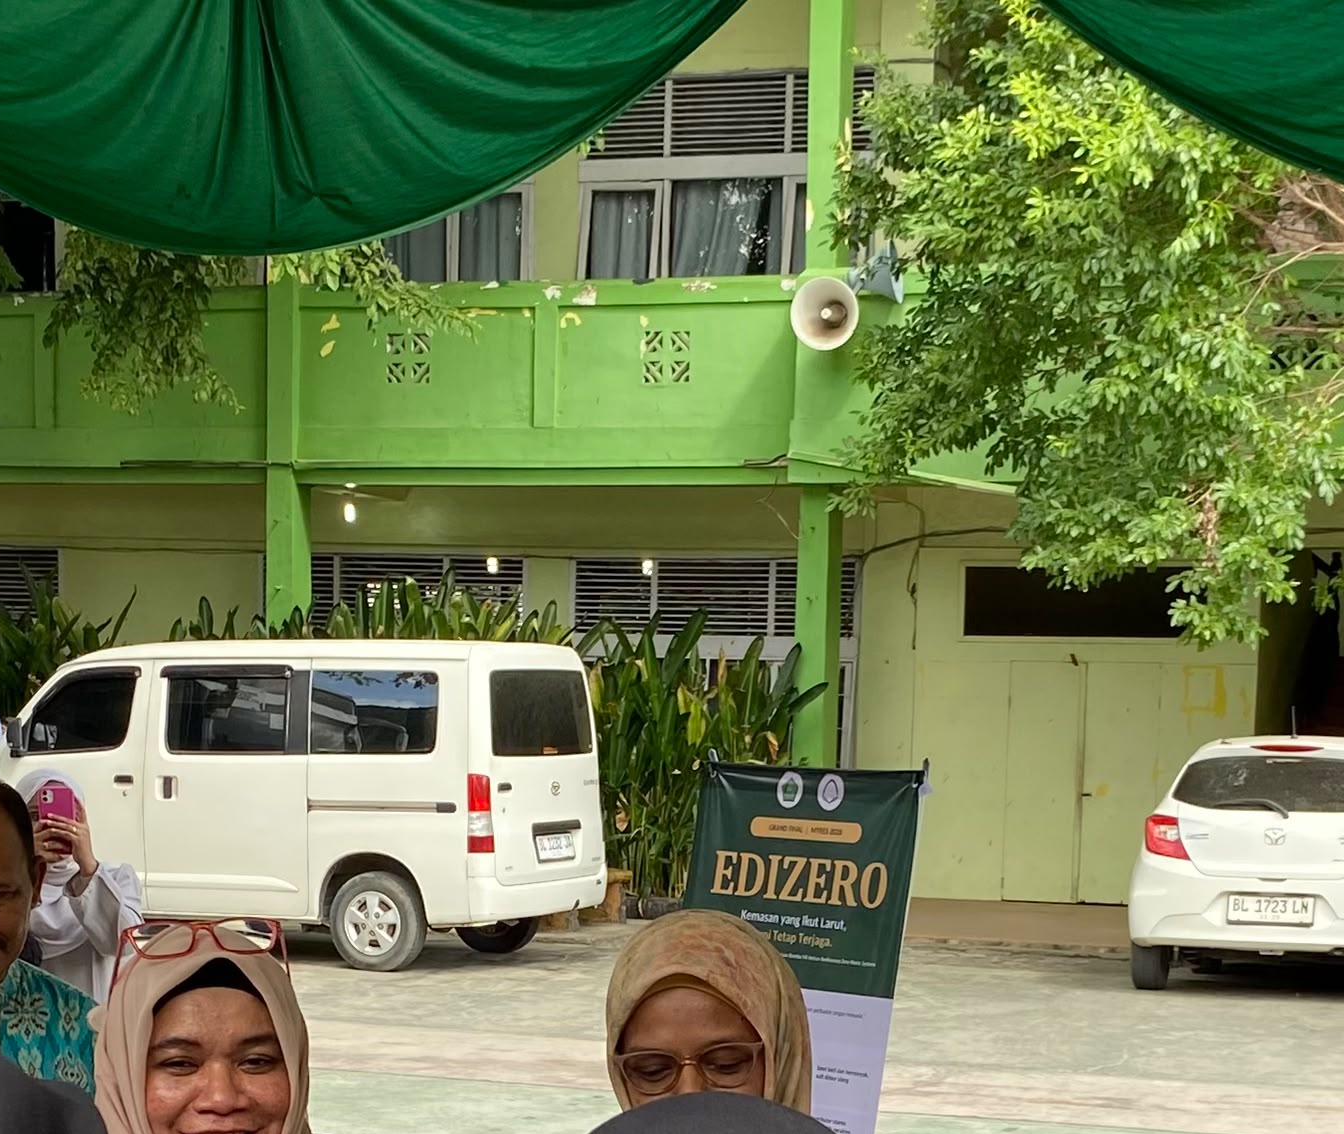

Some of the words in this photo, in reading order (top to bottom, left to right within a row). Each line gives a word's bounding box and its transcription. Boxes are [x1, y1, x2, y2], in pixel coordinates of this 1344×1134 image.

[710, 850, 888, 910] EDIZERO
[1232, 898, 1248, 912] BL
[1254, 900, 1288, 913] 1723
[1292, 900, 1309, 914] LN
[740, 909, 779, 924] Kemasan
[780, 915, 801, 928] yang
[801, 915, 819, 928] Ikut
[820, 917, 847, 932] Larut,
[773, 930, 797, 944] Tetap
[798, 932, 832, 949] Terjaga.
